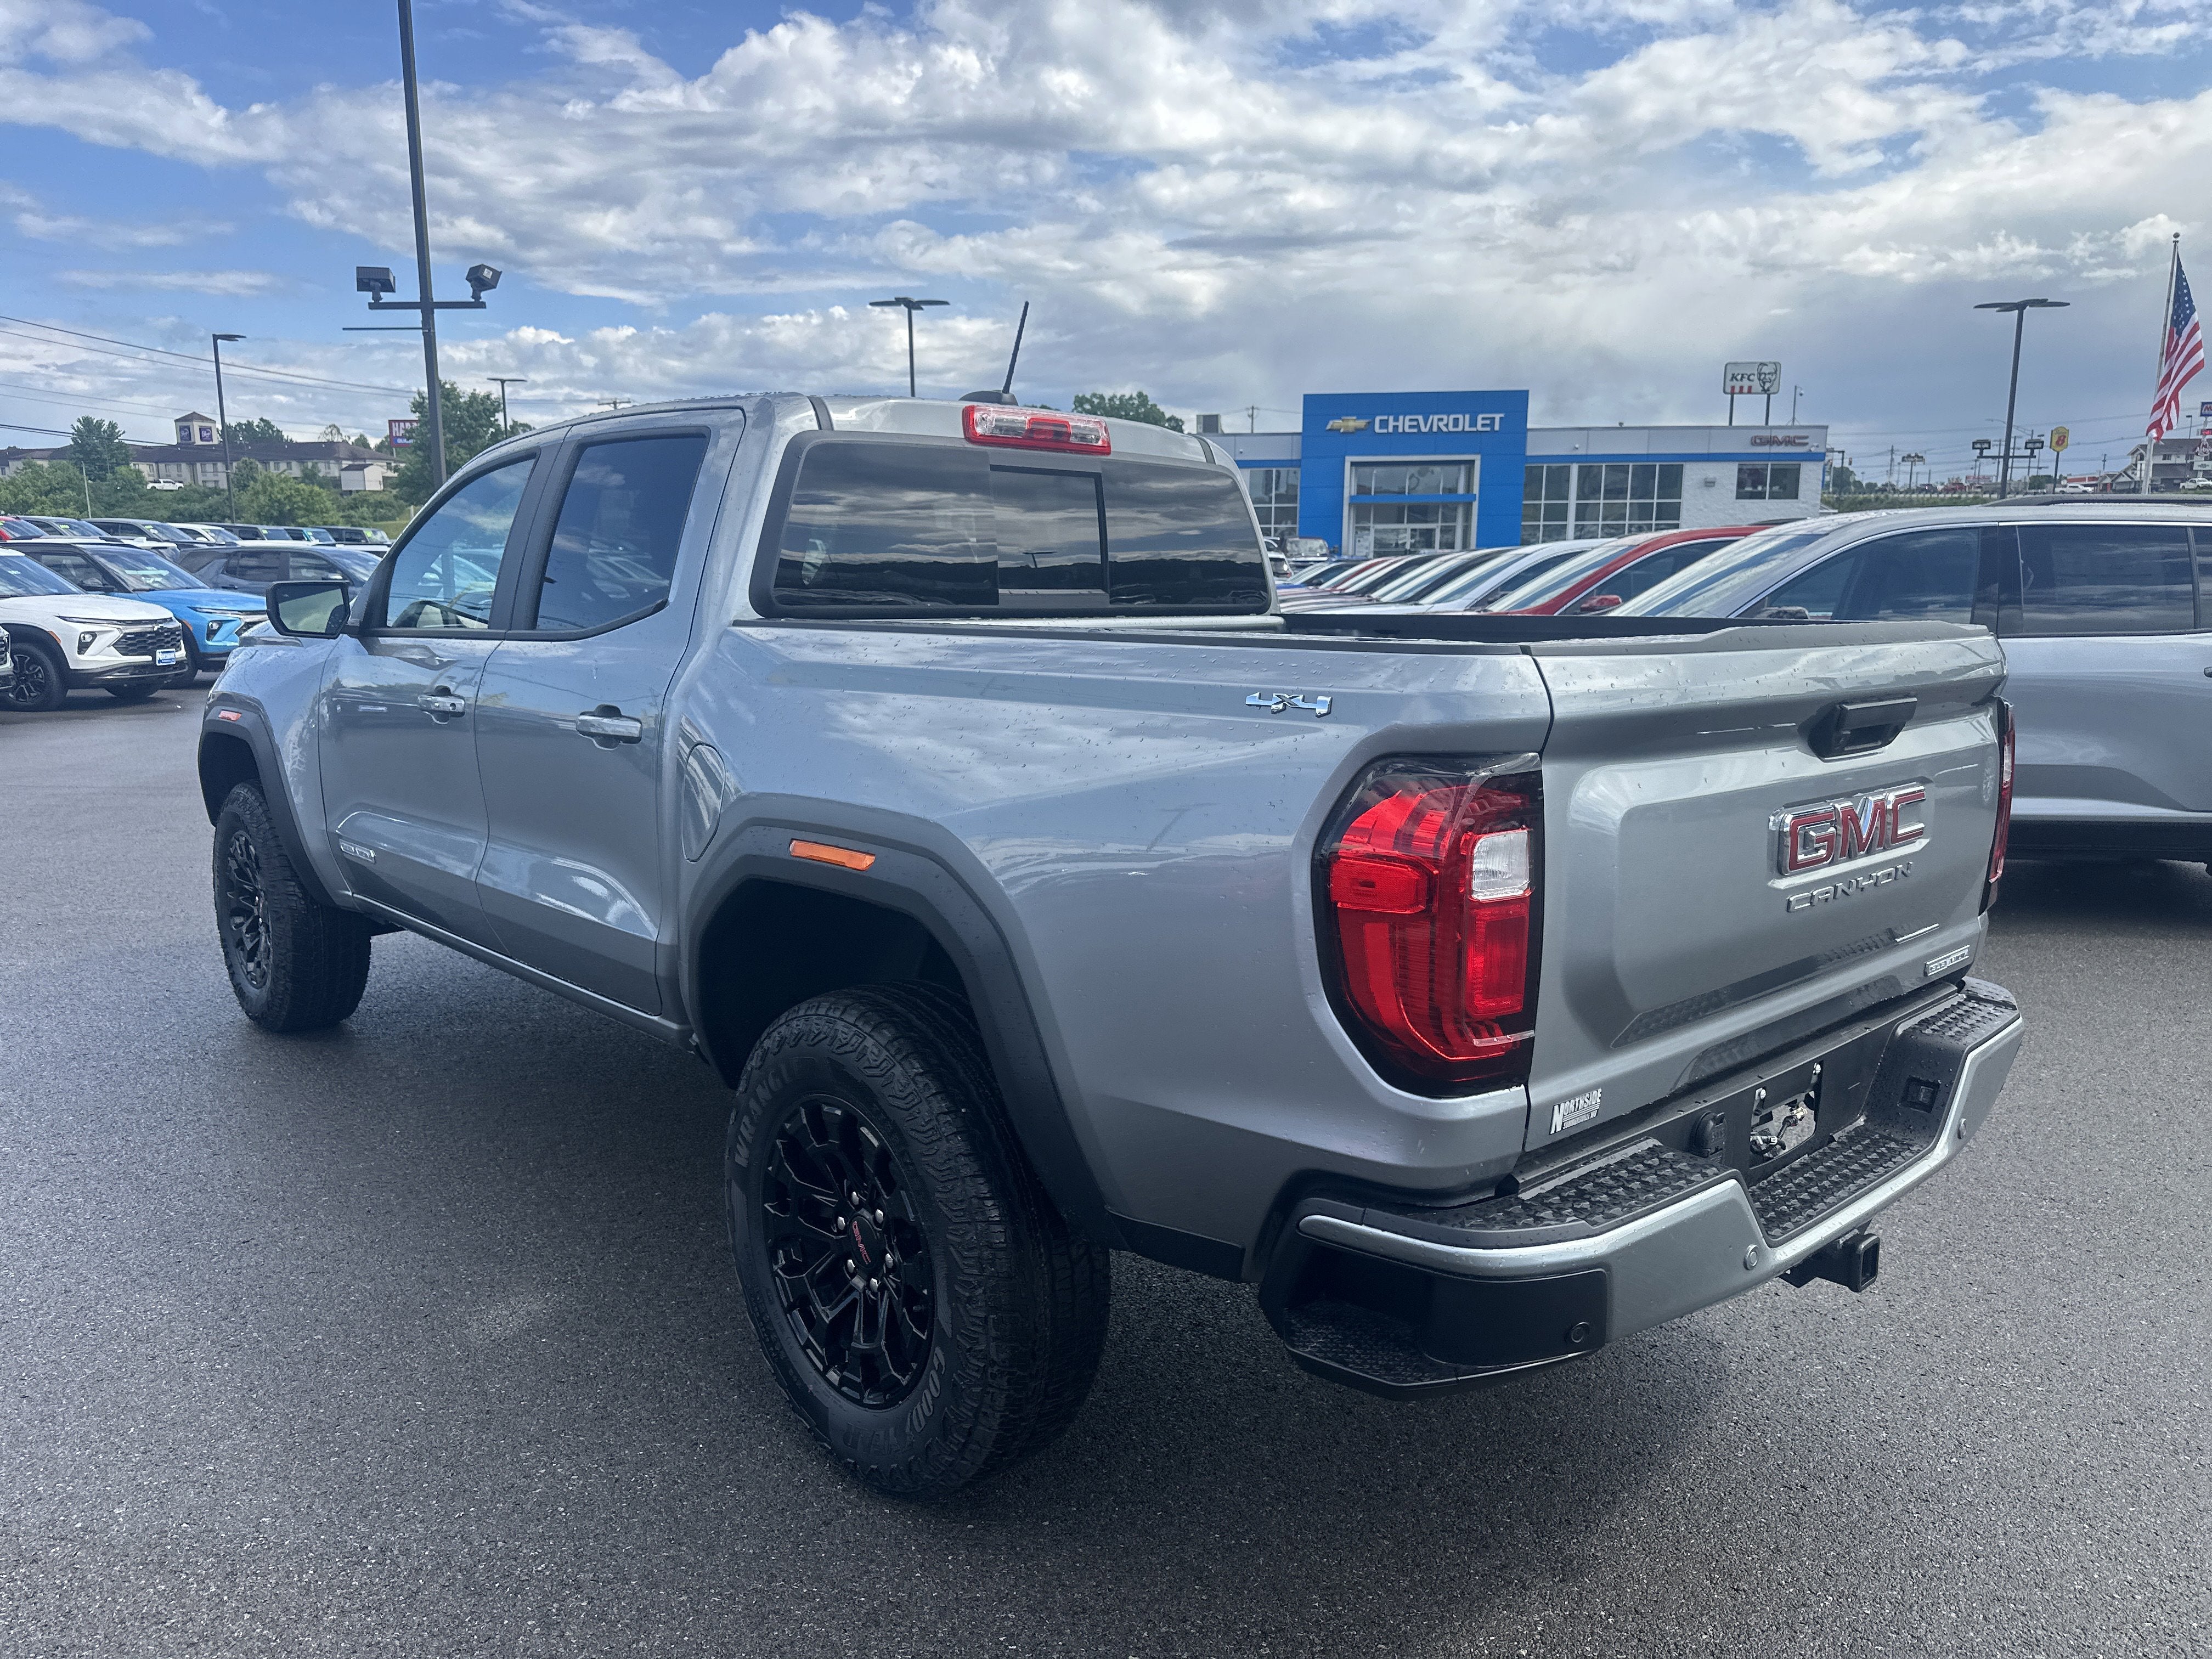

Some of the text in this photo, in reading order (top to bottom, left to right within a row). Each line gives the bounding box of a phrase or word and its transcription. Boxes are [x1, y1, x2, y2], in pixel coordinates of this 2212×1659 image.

[1729, 373, 1755, 382] KFC
[1374, 413, 1505, 433] CHEVROLET
[1751, 435, 1809, 447] GMC
[1776, 785, 1927, 876] GMC
[1786, 861, 1914, 913] CANYON
[1550, 1088, 1602, 1135] NORTHSIDE
[852, 1220, 871, 1265] GMC
